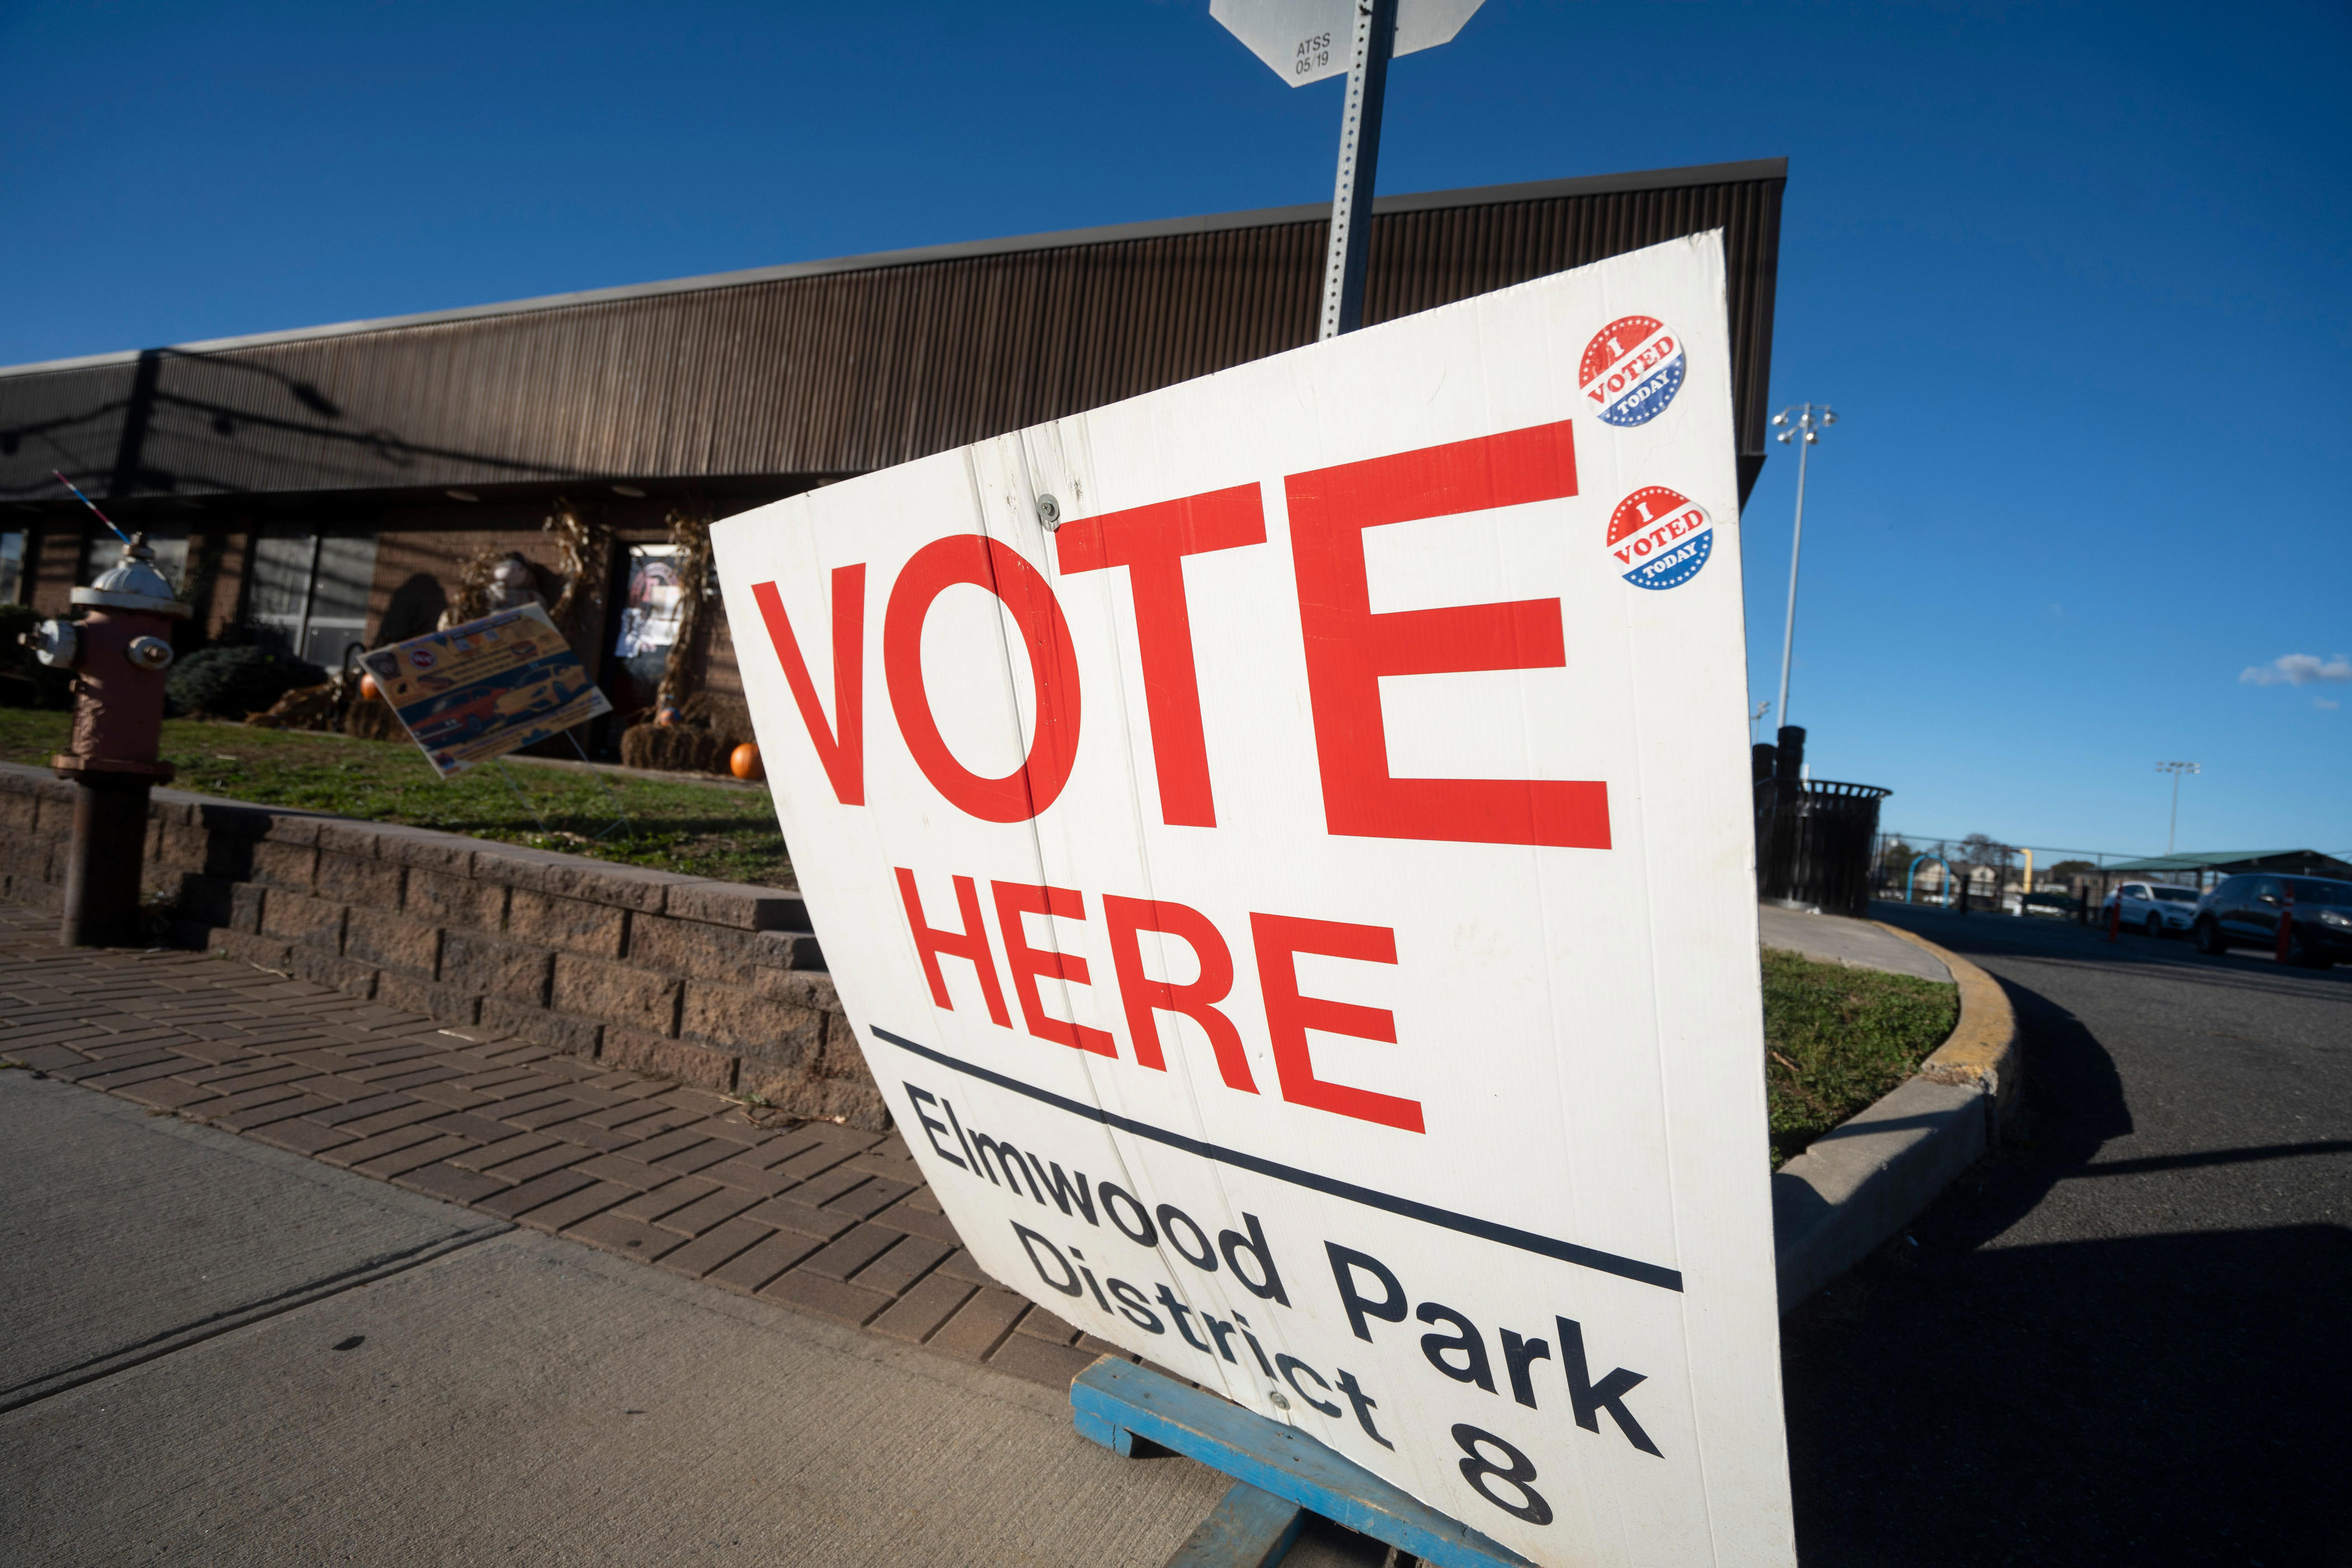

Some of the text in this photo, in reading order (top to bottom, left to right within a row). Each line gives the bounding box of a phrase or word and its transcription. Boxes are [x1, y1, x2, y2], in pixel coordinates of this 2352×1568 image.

[1296, 51, 1329, 74] 05/19
[1297, 32, 1330, 56] ATSS
[1588, 336, 1674, 404] VOTED
[1607, 337, 1624, 357] I
[1617, 370, 1670, 415] TODAY
[1613, 509, 1703, 565] VOTED
[1636, 502, 1654, 522] I
[1642, 542, 1697, 579] TODAY
[751, 419, 1612, 849] VOTE
[894, 866, 1426, 1135] HERE
[902, 1080, 1665, 1460] Elmwood Park
[1009, 1218, 1553, 1526] District 8
